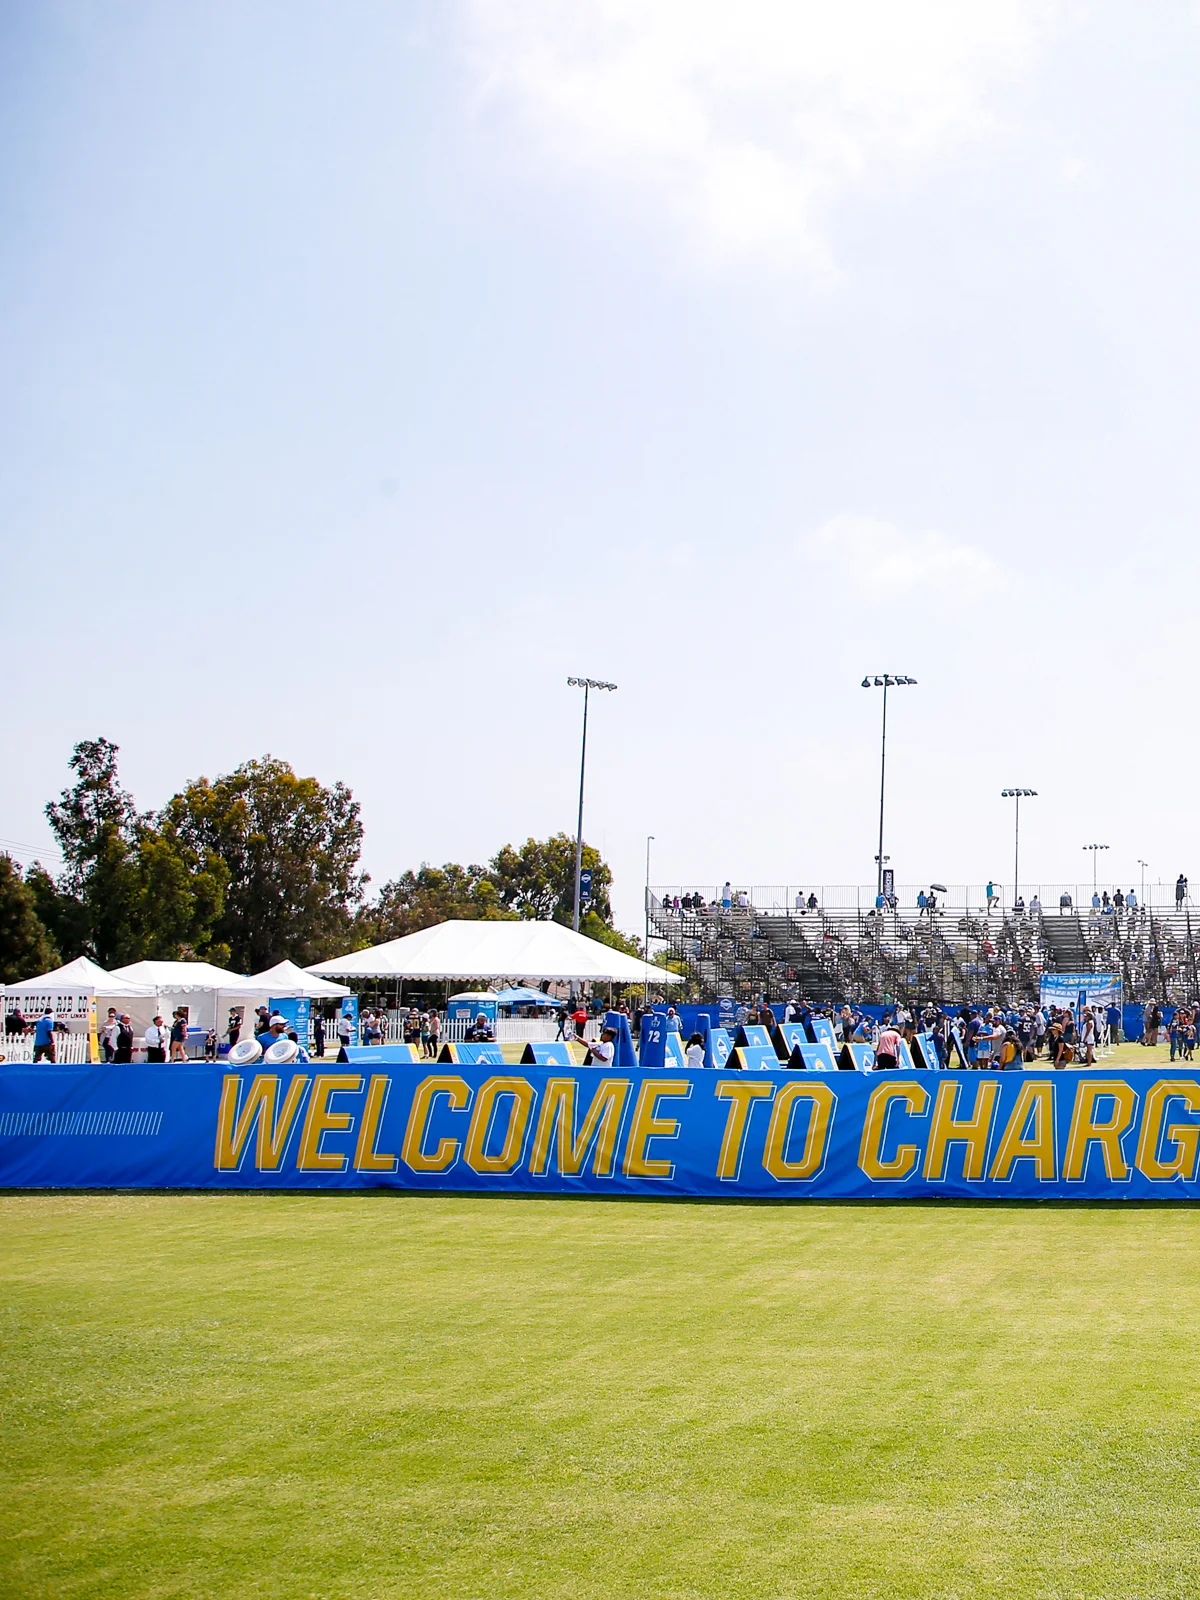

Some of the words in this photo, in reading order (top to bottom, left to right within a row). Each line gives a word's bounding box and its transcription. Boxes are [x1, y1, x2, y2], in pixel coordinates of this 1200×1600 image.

[4, 996, 20, 1013] THE
[24, 996, 51, 1013] TULSA
[214, 1073, 693, 1180] WELCOME
[714, 1080, 838, 1182] TO
